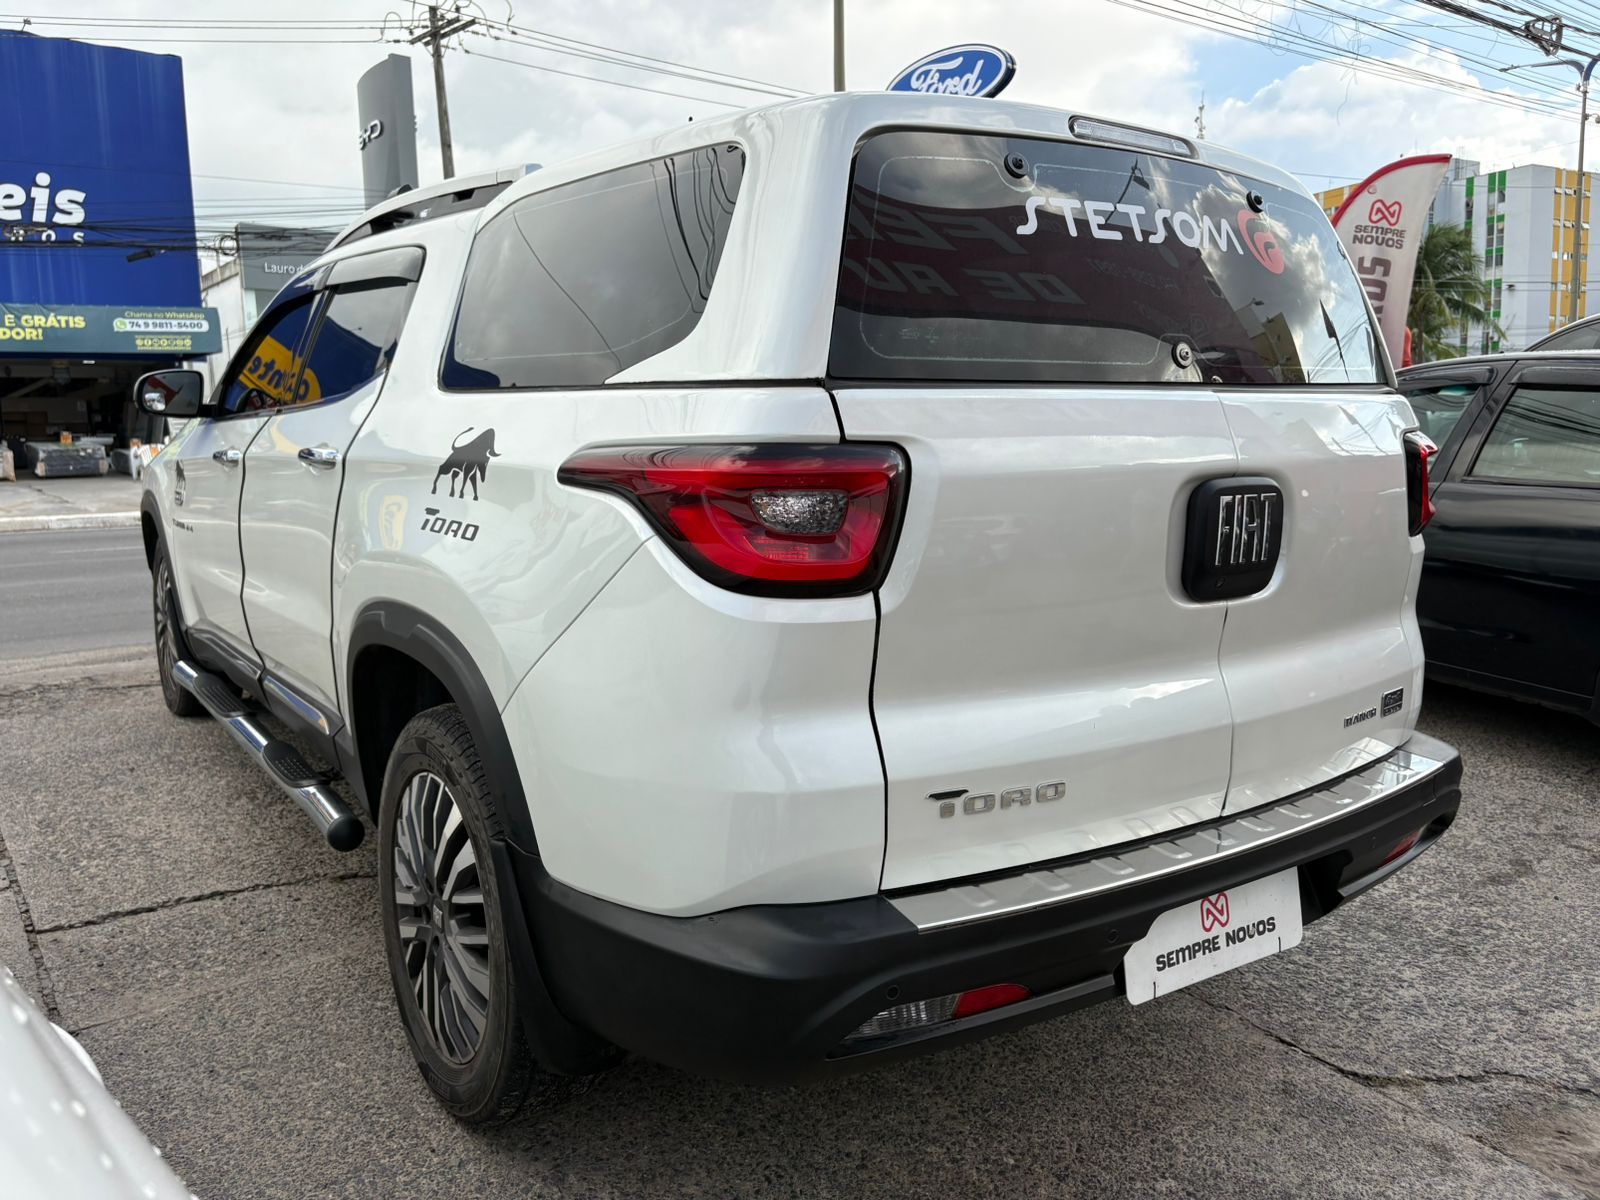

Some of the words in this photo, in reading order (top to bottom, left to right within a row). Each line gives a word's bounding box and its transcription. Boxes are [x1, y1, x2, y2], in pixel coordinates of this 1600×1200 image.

[910, 56, 984, 96] Ford
[0, 172, 86, 225] eis
[1016, 196, 1244, 255] STETSOM
[1353, 224, 1406, 239] SEMPRE
[264, 261, 295, 274] Lauro
[21, 312, 86, 329] GRÁTIS
[164, 312, 205, 320] WhatsApp
[420, 507, 480, 541] TORO
[1215, 493, 1277, 566] FIAT
[925, 780, 1066, 818] TORO
[1155, 935, 1221, 972] SEMPRE
